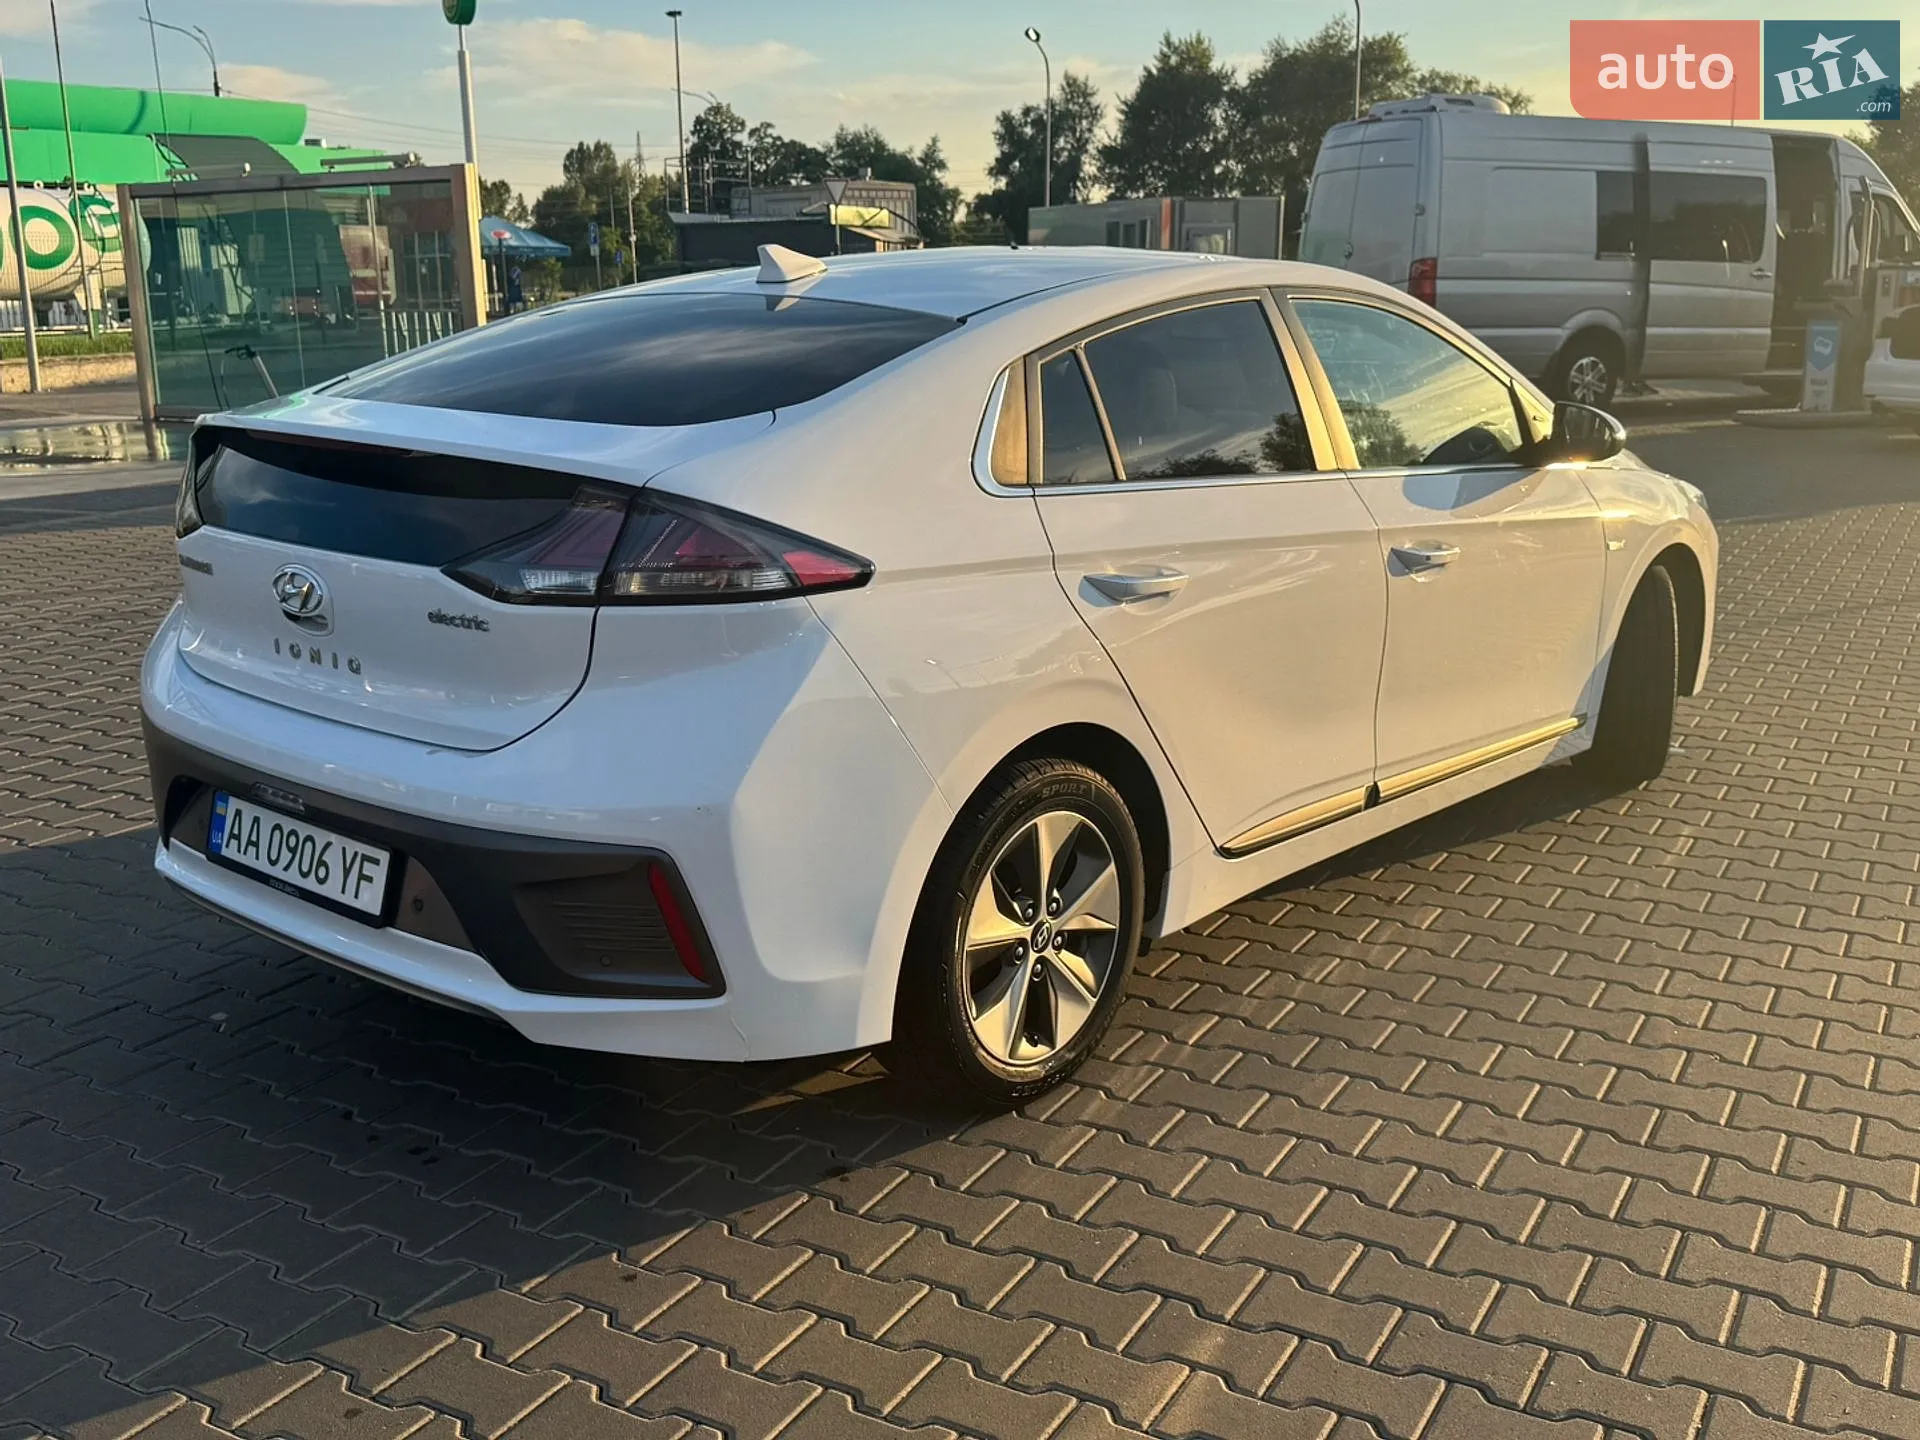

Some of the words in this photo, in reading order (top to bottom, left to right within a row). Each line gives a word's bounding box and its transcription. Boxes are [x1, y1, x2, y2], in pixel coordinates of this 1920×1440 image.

[427, 608, 489, 632] electric
[274, 637, 361, 675] IONIQ
[1042, 782, 1088, 799] SPORT
[225, 808, 260, 861] AA
[267, 822, 333, 885] 0906
[341, 845, 381, 900] YF
